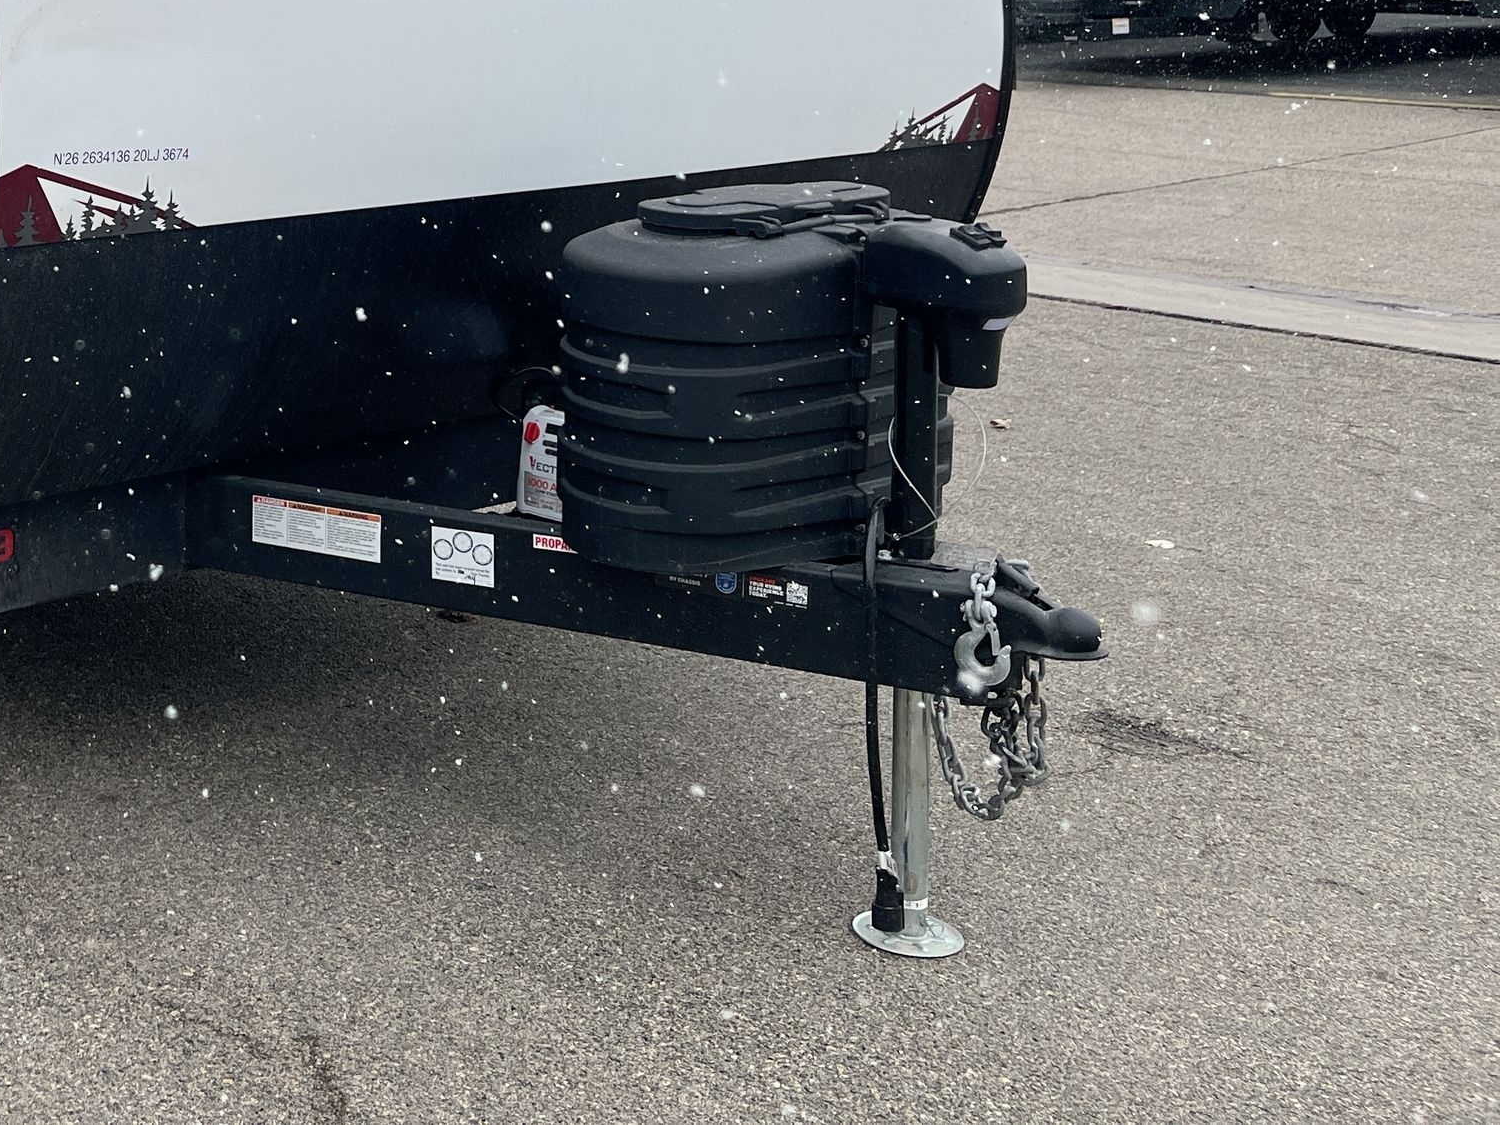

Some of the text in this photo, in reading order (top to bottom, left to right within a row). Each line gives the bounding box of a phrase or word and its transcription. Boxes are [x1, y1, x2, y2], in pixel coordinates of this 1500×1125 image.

[81, 149, 131, 165] 2634136
[133, 148, 160, 163] 20LJ
[162, 147, 190, 161] 3674
[535, 536, 571, 551] PROPA
